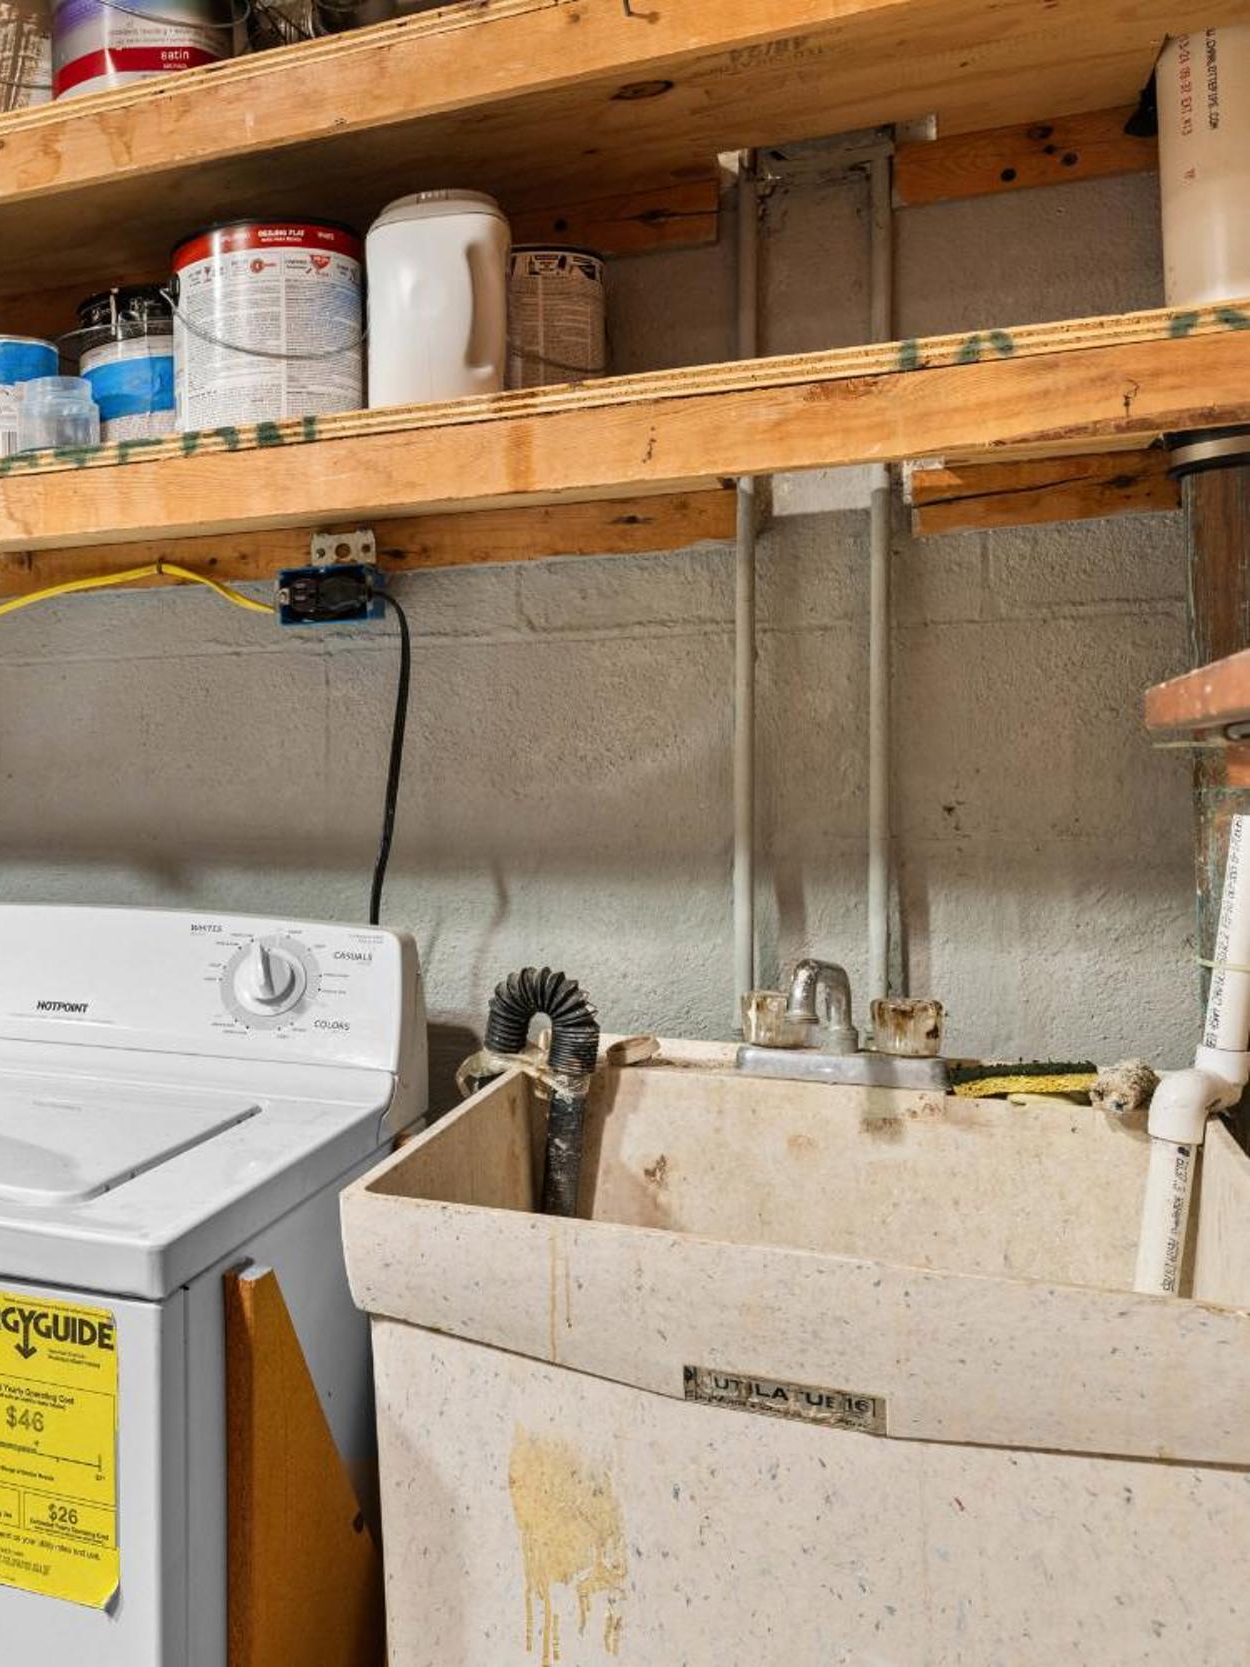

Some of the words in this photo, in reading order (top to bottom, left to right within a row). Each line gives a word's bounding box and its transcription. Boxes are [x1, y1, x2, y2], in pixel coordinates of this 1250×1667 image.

[161, 50, 190, 61] satin
[334, 951, 373, 962] CASUALS
[36, 1000, 89, 1014] HOTPOINT
[314, 1019, 350, 1032] COLORS
[4, 1384, 24, 1396] Yearly
[59, 1395, 75, 1406] Cost
[6, 1405, 44, 1432] $46
[48, 1504, 78, 1525] $26
